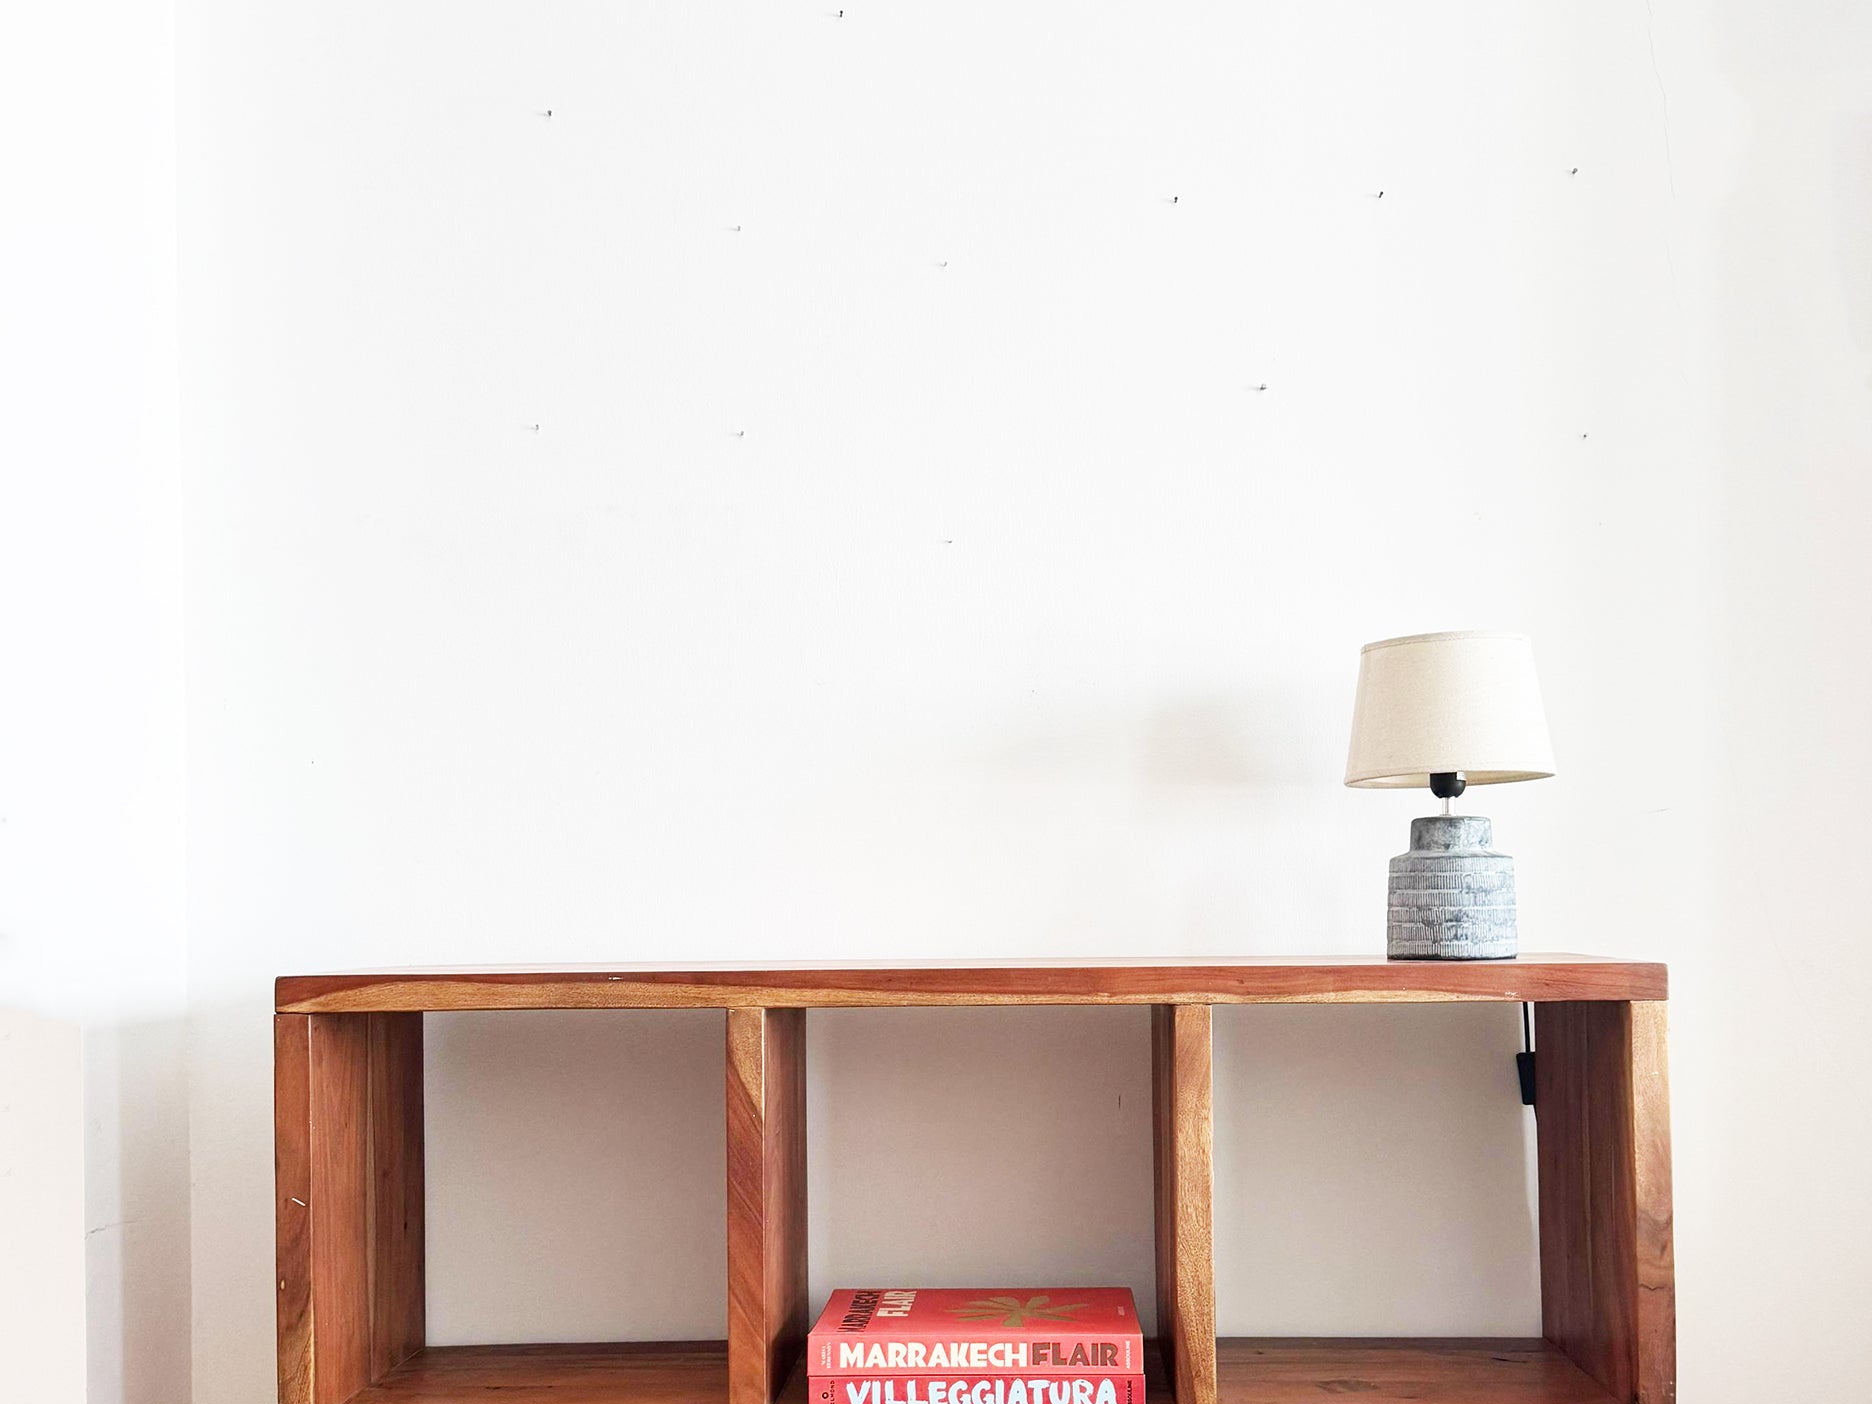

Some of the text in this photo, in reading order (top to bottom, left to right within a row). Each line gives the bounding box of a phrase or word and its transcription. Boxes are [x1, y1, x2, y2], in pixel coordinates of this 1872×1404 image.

[876, 1290, 917, 1317] FLAIR
[839, 1342, 1119, 1369] MARRAKECH FLAIR
